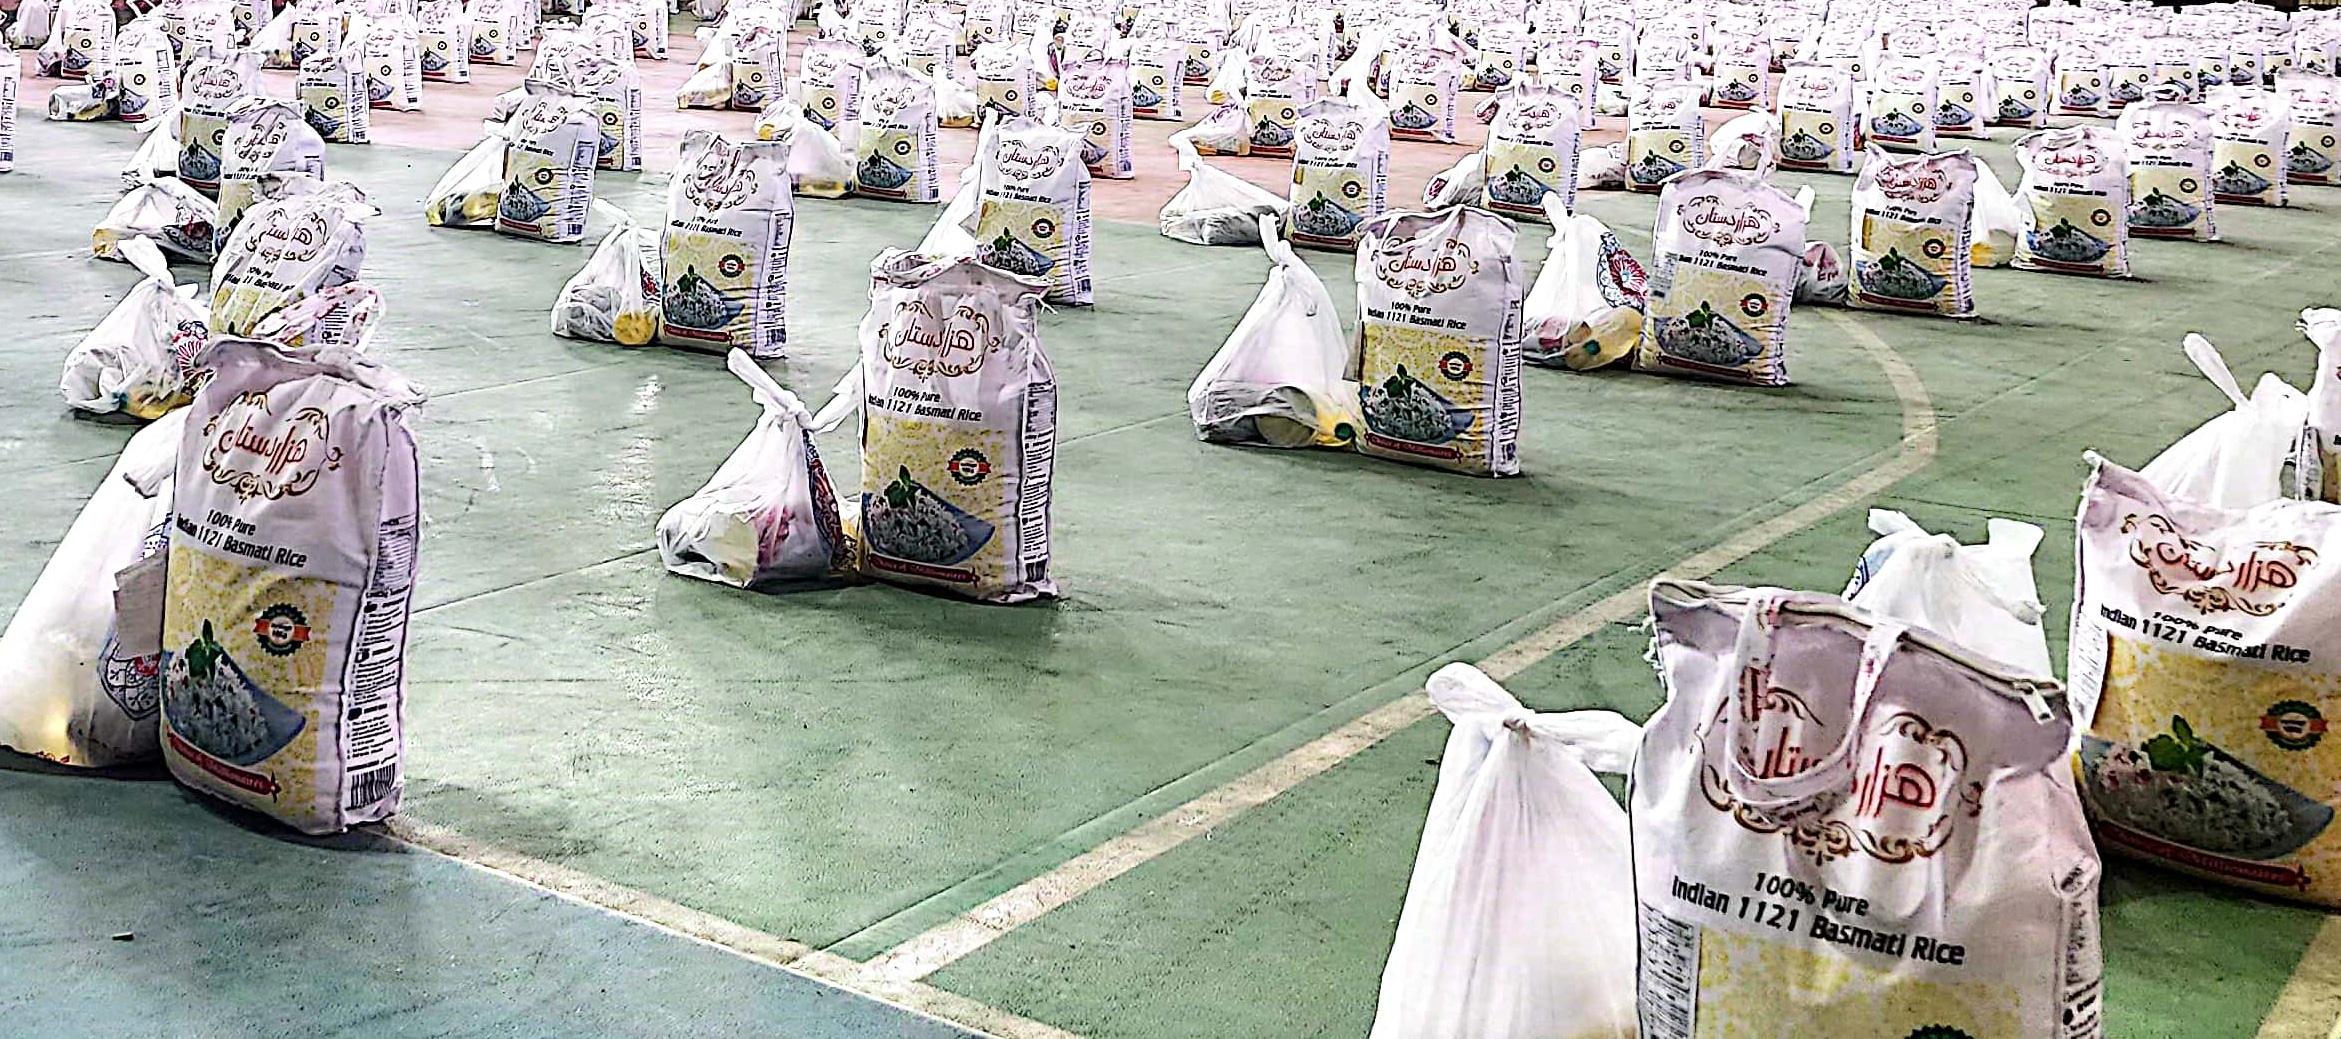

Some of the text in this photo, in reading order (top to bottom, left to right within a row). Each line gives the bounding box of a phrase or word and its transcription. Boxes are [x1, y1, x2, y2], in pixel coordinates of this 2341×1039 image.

[1386, 311, 1407, 323] 1121
[886, 399, 913, 414] 1121
[957, 408, 983, 422] Rice
[893, 386, 920, 403] 100%
[231, 516, 256, 536] Pure
[197, 526, 221, 548] 1121
[223, 535, 274, 562] Basmati
[274, 546, 307, 568] Rice
[2100, 603, 2138, 630] Indian
[2141, 618, 2188, 644] 1121
[2270, 644, 2312, 664] Rice
[1754, 872, 1870, 916] 100% Pure
[1671, 875, 1966, 966] Indian 1121 Basmati Rice
